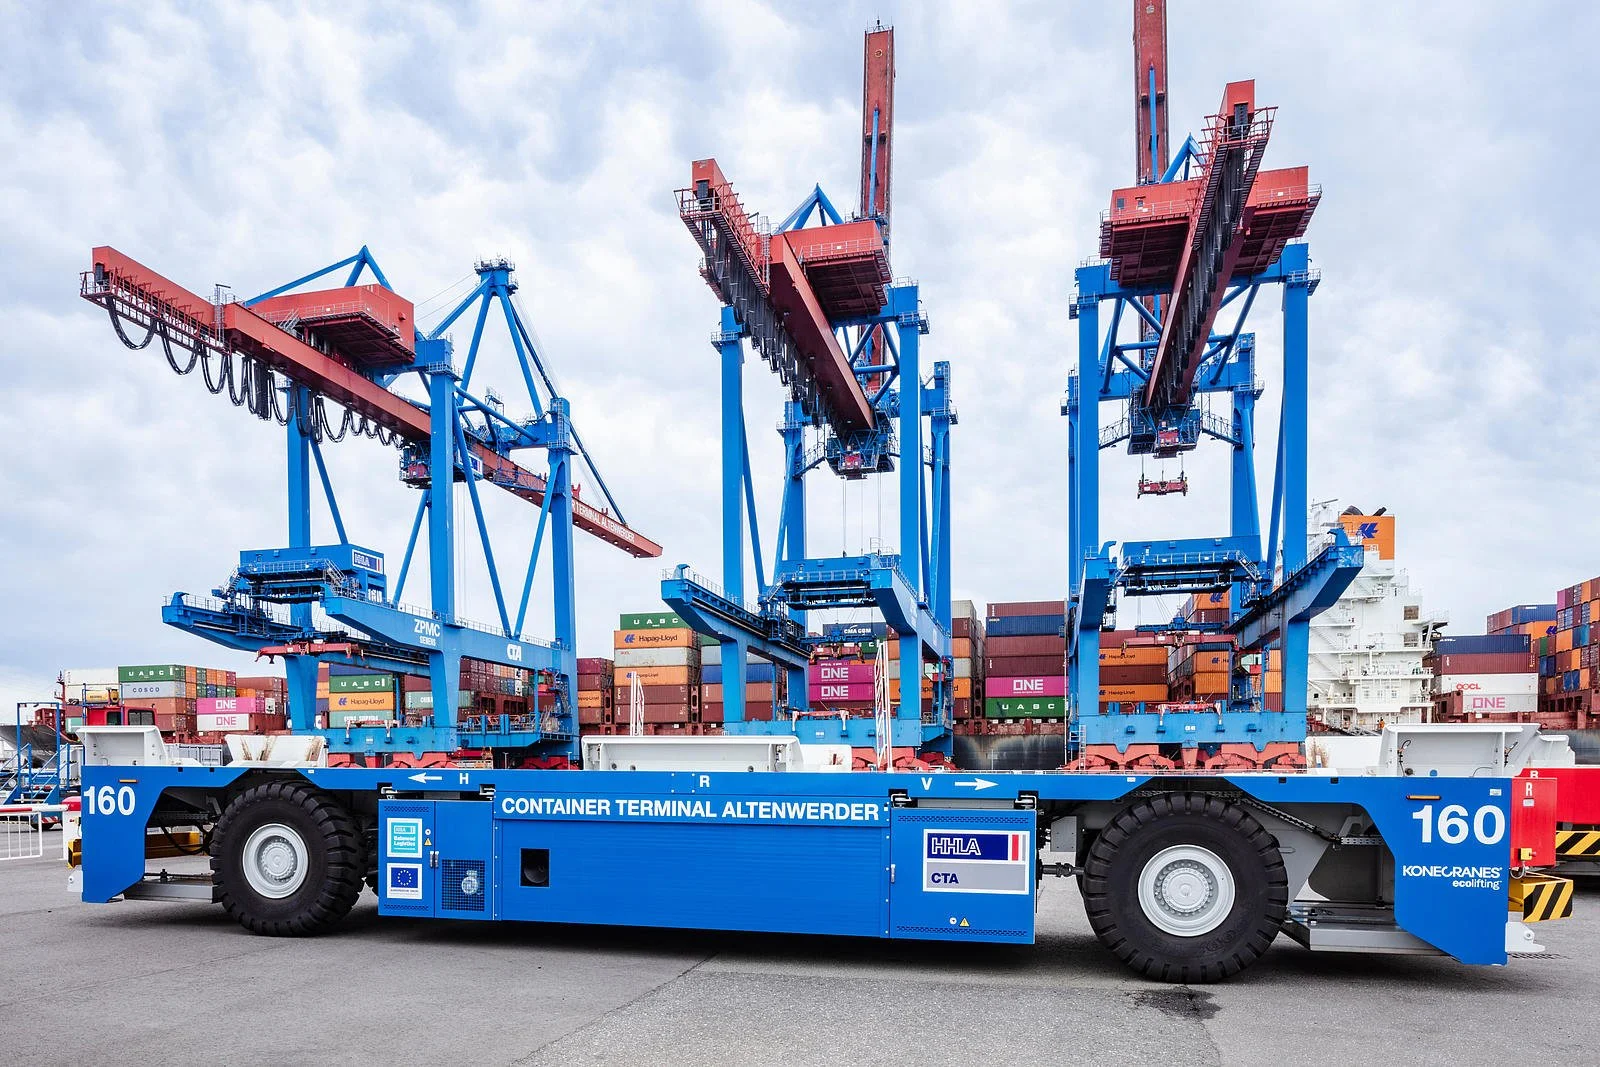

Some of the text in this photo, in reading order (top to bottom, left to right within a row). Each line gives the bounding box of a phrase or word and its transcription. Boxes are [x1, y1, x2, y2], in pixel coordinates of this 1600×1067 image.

[414, 618, 441, 637] ZPMC
[506, 643, 522, 662] CTA
[822, 667, 849, 678] ONE
[822, 685, 849, 696] ONE
[1013, 679, 1044, 690] ONE
[215, 699, 237, 709] ONE
[350, 697, 385, 706] Hapag-Lloyd
[1472, 697, 1506, 709] ONE
[215, 716, 237, 726] ONE
[459, 773, 469, 785] H
[700, 775, 710, 788] R
[921, 777, 933, 791] V
[1525, 782, 1533, 797] R
[84, 785, 135, 816] 160
[501, 797, 880, 822] CONTAINER TERMINAL ALTENWERDER
[1412, 804, 1506, 845] 160
[931, 837, 981, 856] HHLA
[931, 872, 959, 884] CTA
[1402, 865, 1501, 879] KONECRANES
[1452, 879, 1501, 891] ecolifting
